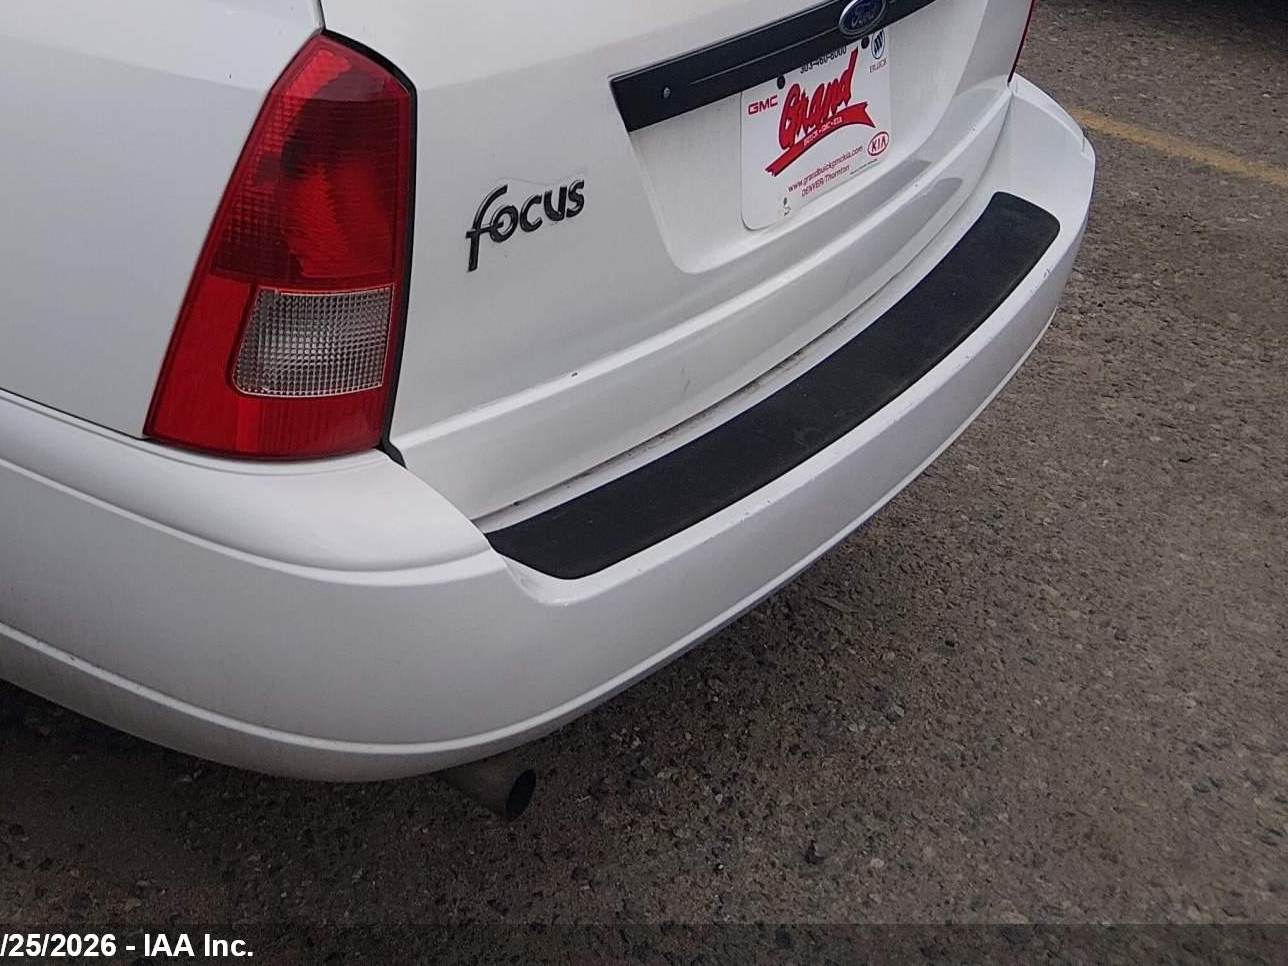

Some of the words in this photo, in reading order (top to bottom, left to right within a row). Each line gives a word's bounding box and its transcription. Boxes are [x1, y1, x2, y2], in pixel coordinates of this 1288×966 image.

[748, 94, 779, 115] GMC
[778, 46, 859, 151] Grand
[870, 135, 887, 153] KIA
